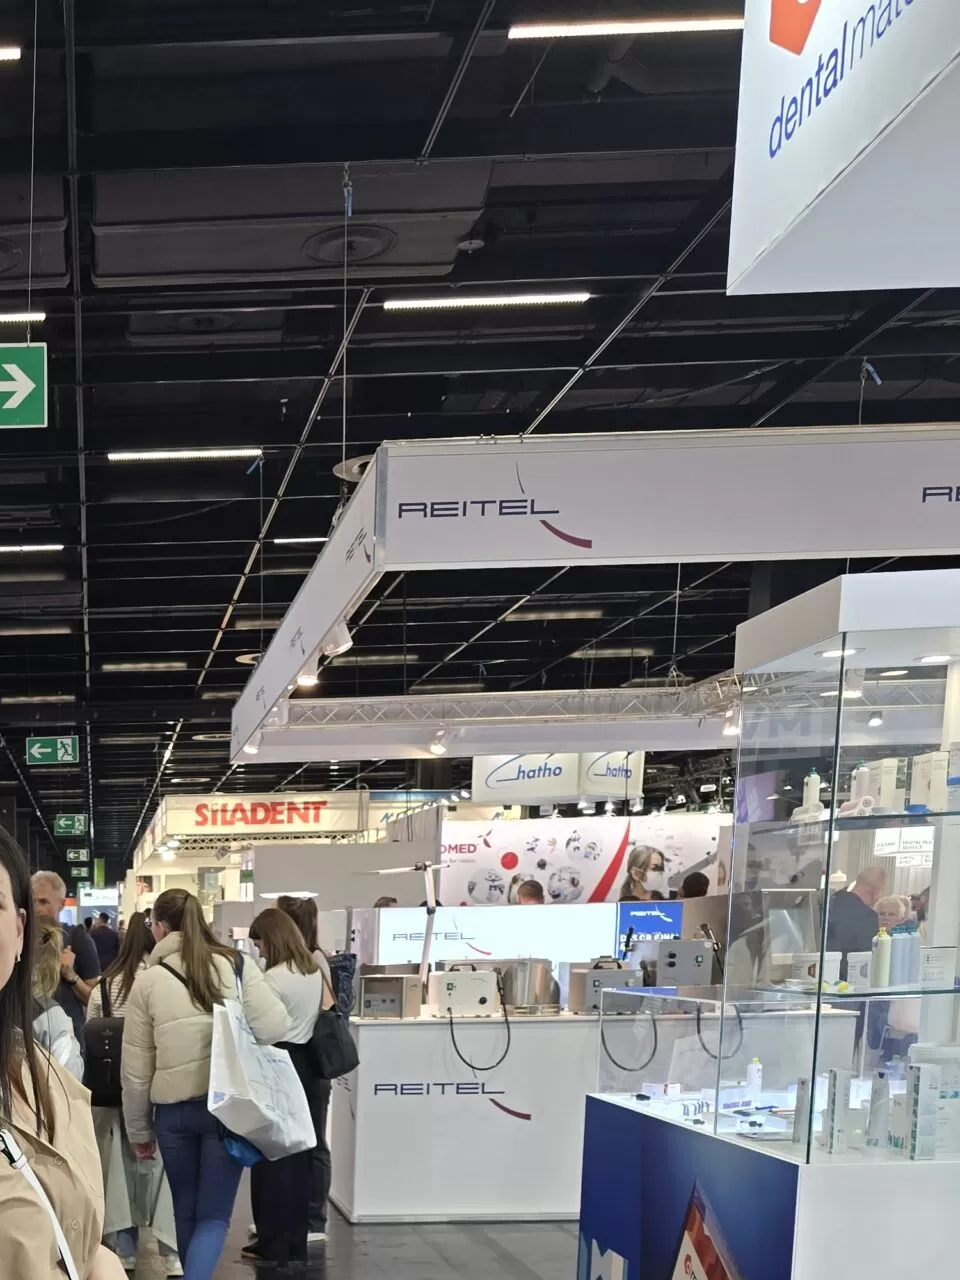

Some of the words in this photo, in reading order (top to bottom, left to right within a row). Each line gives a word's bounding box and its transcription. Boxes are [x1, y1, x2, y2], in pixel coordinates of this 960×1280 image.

[922, 486, 960, 503] R
[398, 499, 559, 518] REITEL
[517, 762, 563, 780] hatho
[605, 762, 633, 779] hatho
[393, 932, 476, 941] RETEL
[374, 1082, 505, 1096] REITEL
